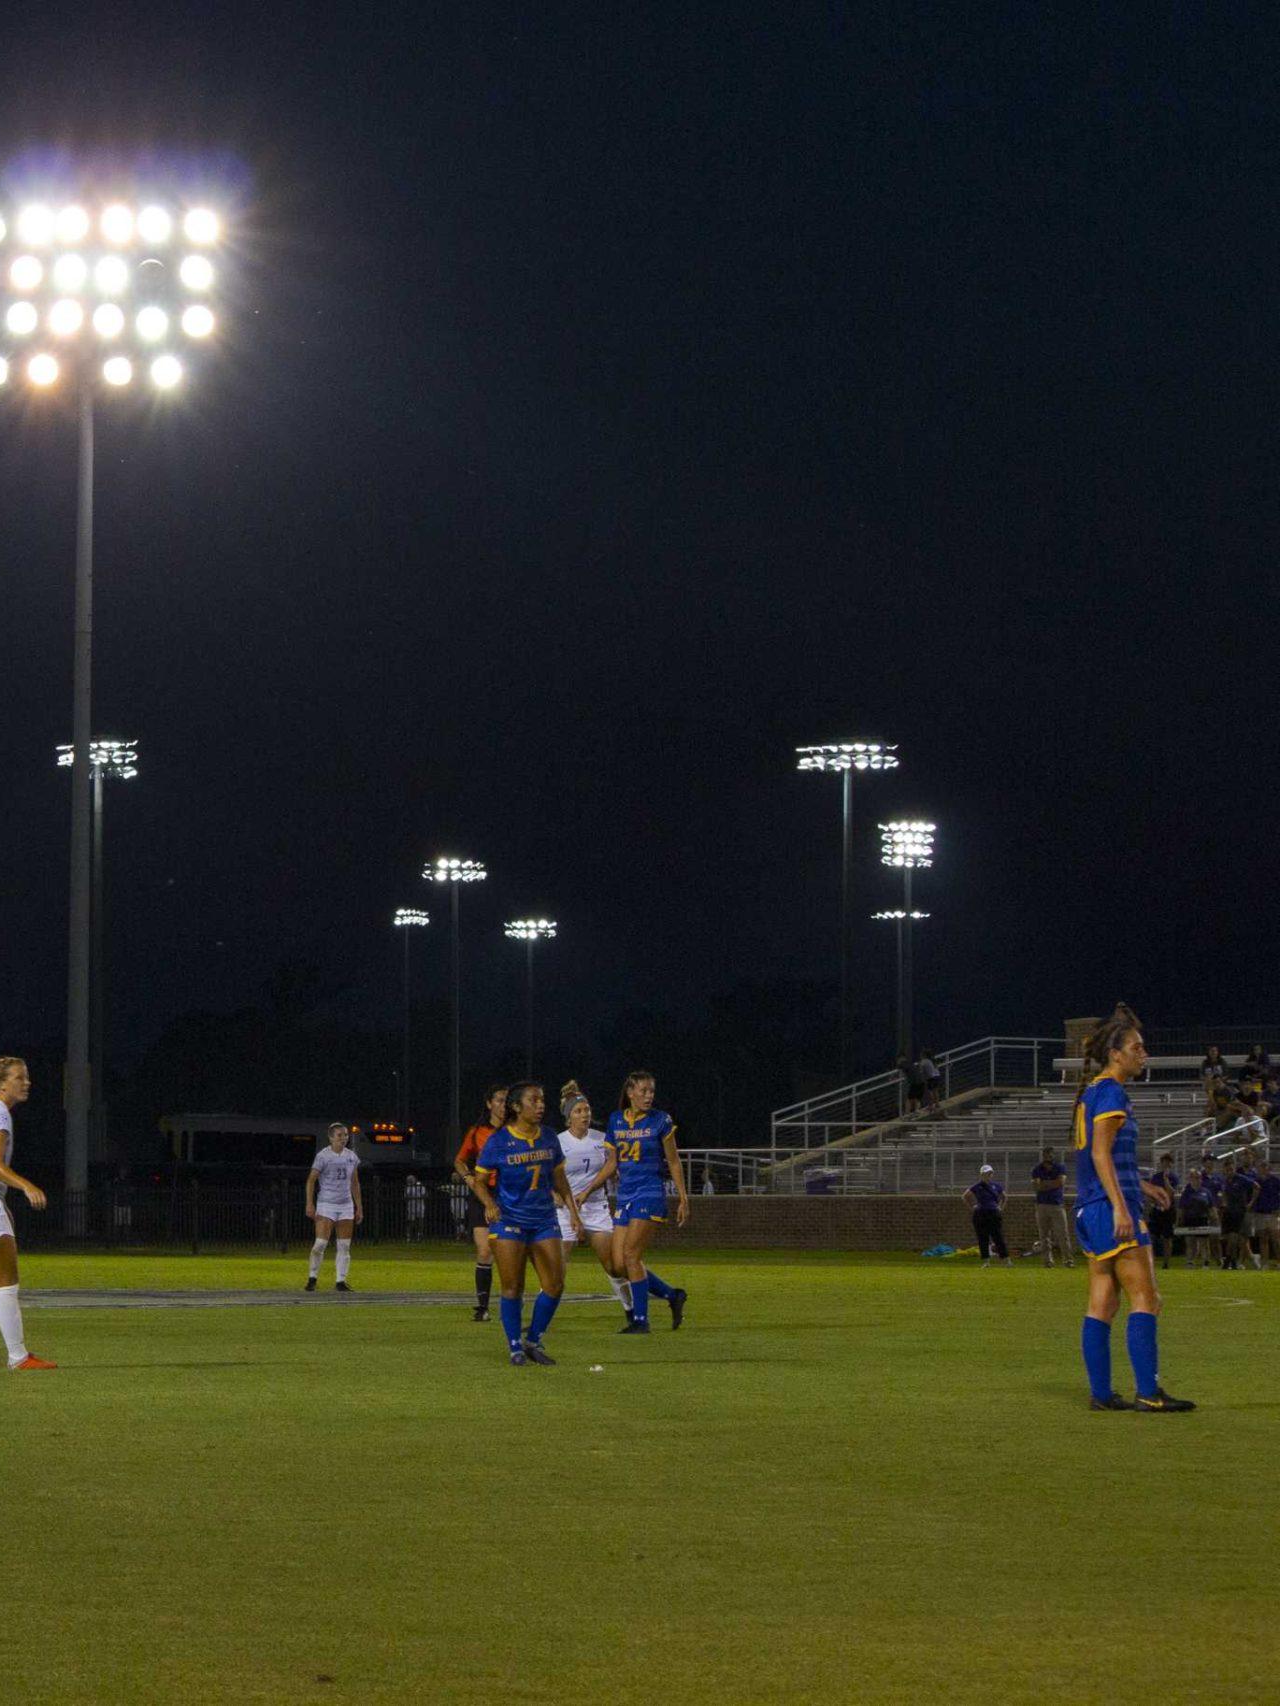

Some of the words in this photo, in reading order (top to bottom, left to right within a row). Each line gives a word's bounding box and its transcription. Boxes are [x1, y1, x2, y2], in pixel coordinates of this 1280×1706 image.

[507, 1149, 555, 1166] COWGIRLS
[618, 1140, 640, 1163] 24
[336, 1168, 348, 1180] 23
[583, 1158, 590, 1173] 7
[526, 1164, 542, 1191] 7
